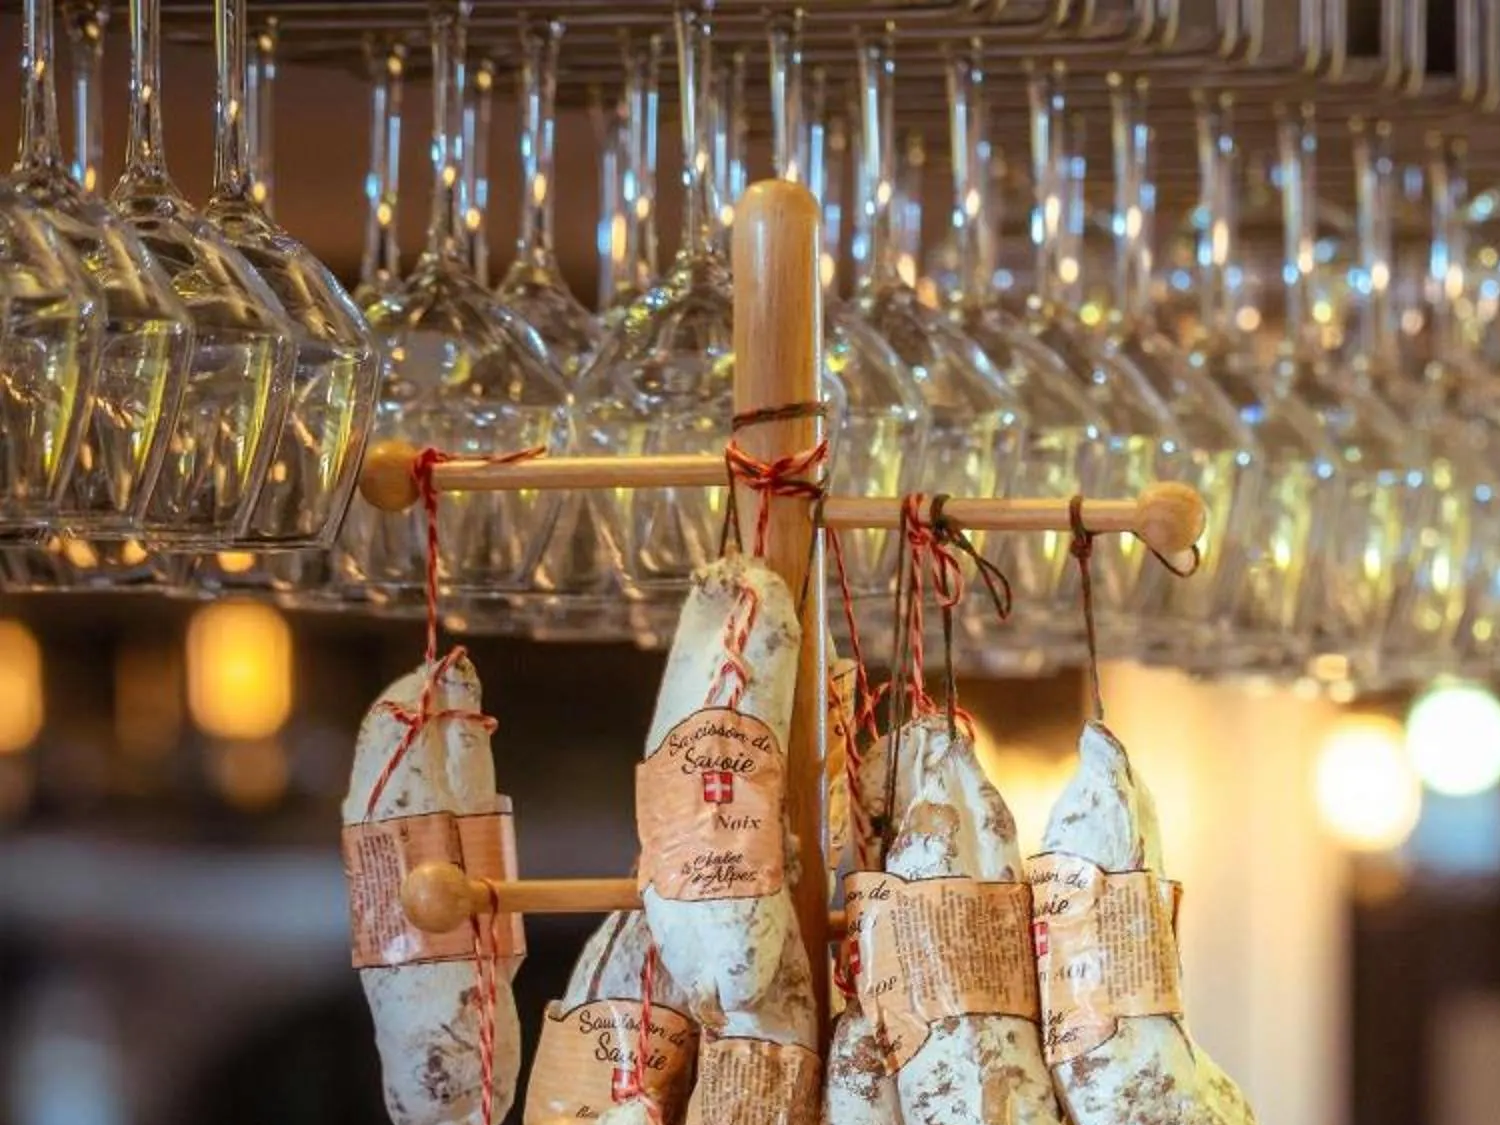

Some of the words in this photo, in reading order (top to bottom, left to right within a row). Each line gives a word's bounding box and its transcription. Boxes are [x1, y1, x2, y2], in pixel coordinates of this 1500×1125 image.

[681, 746, 757, 775] Savoie
[716, 814, 762, 831] Noix
[868, 879, 891, 900] de
[594, 1031, 668, 1071] Saie
